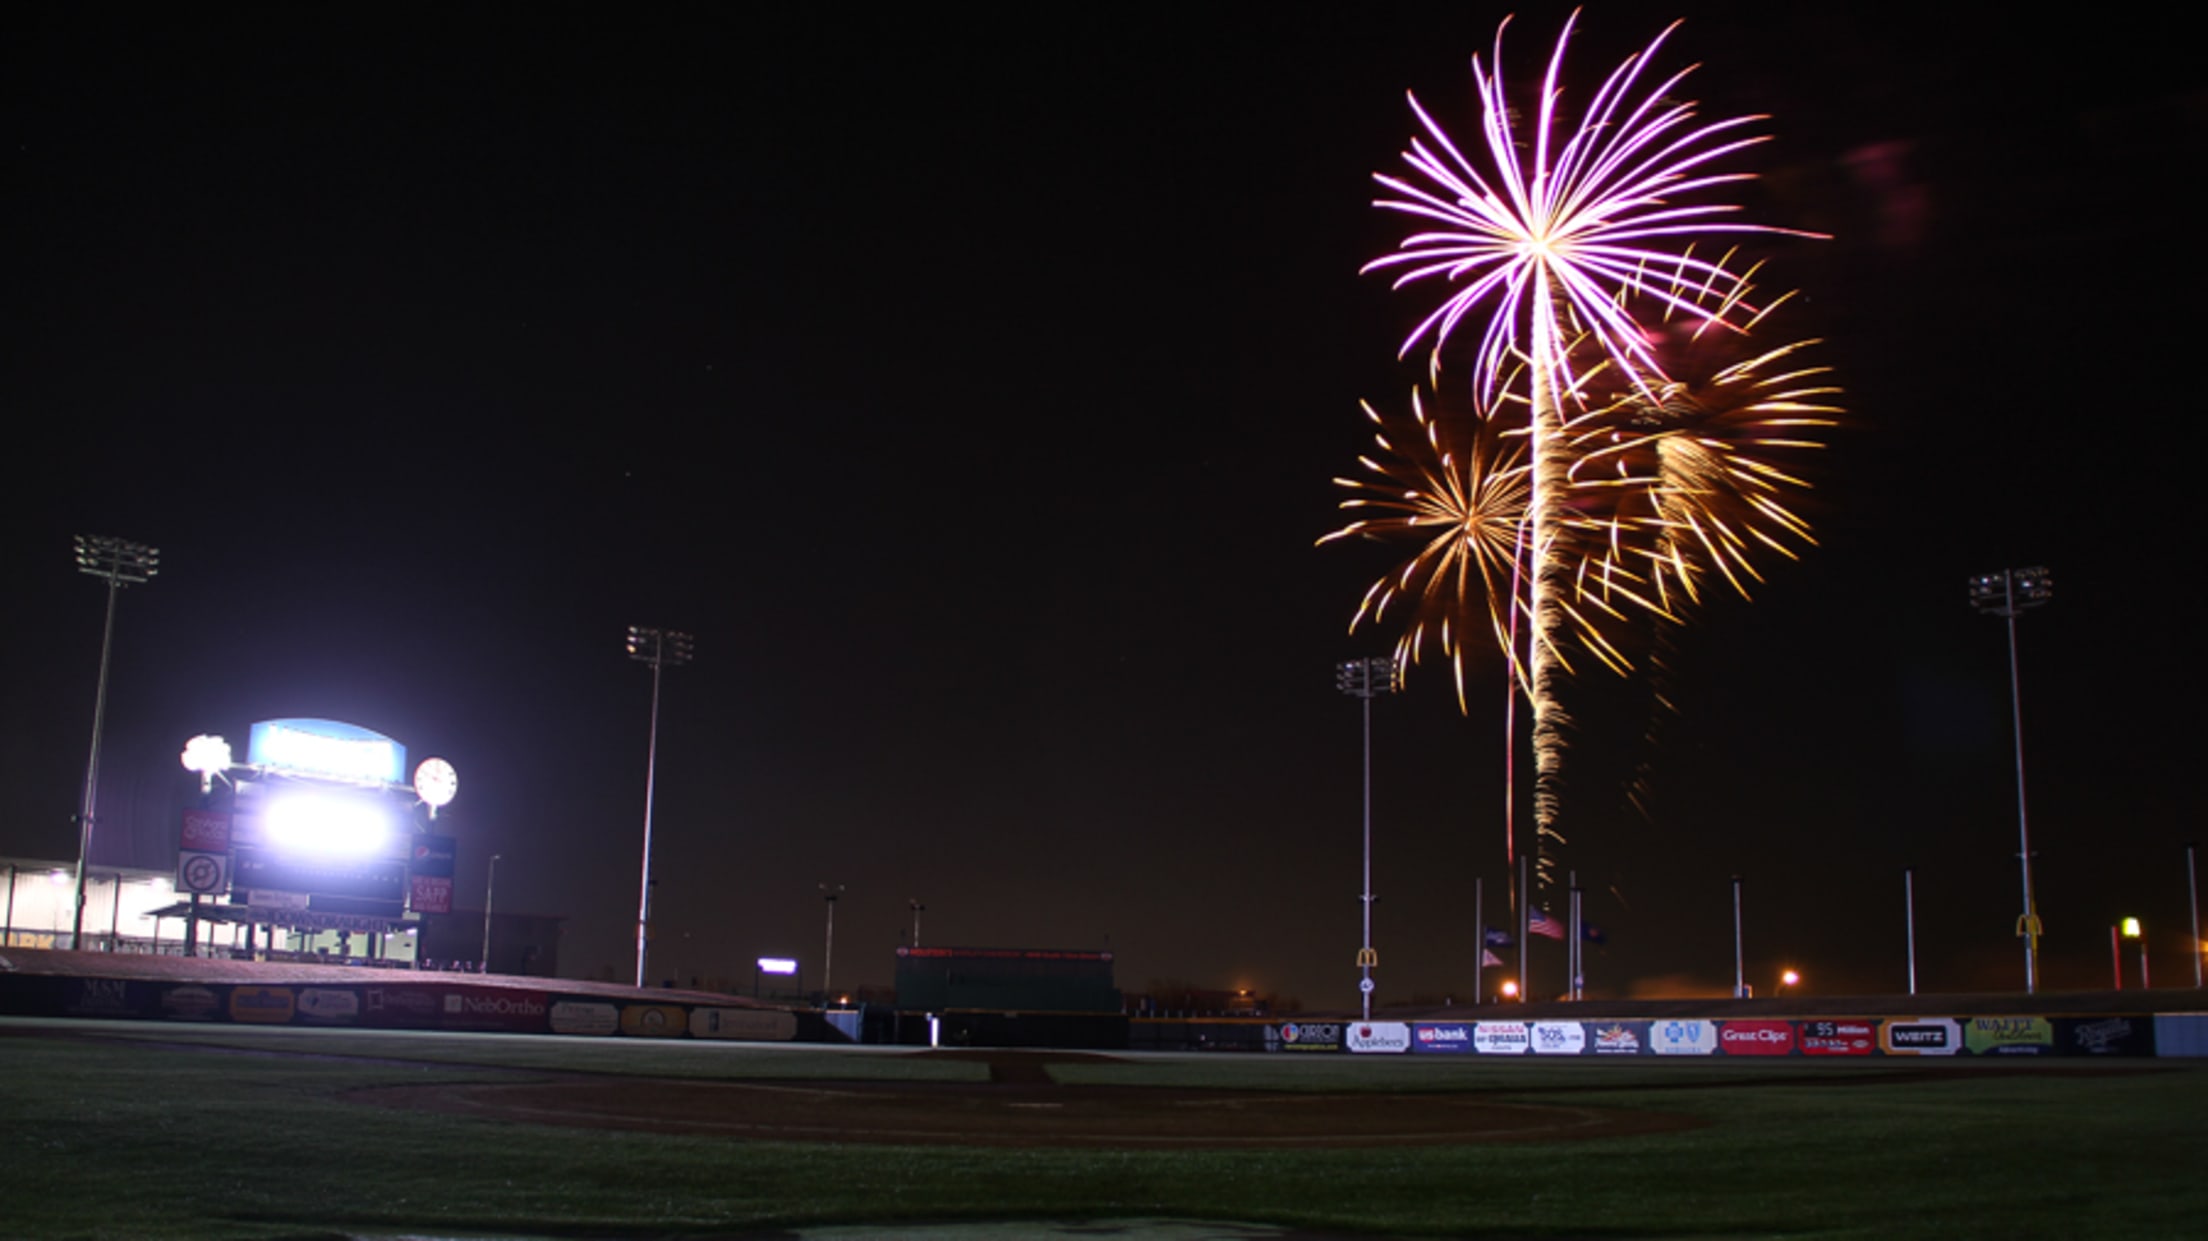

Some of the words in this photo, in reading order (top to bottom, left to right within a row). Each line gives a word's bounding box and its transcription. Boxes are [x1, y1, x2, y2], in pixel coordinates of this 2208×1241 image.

[464, 997, 544, 1016] NebOrtho
[1722, 1029, 1757, 1041] Great
[1758, 1029, 1787, 1043] Clips
[1894, 1031, 1944, 1043] WEITZ
